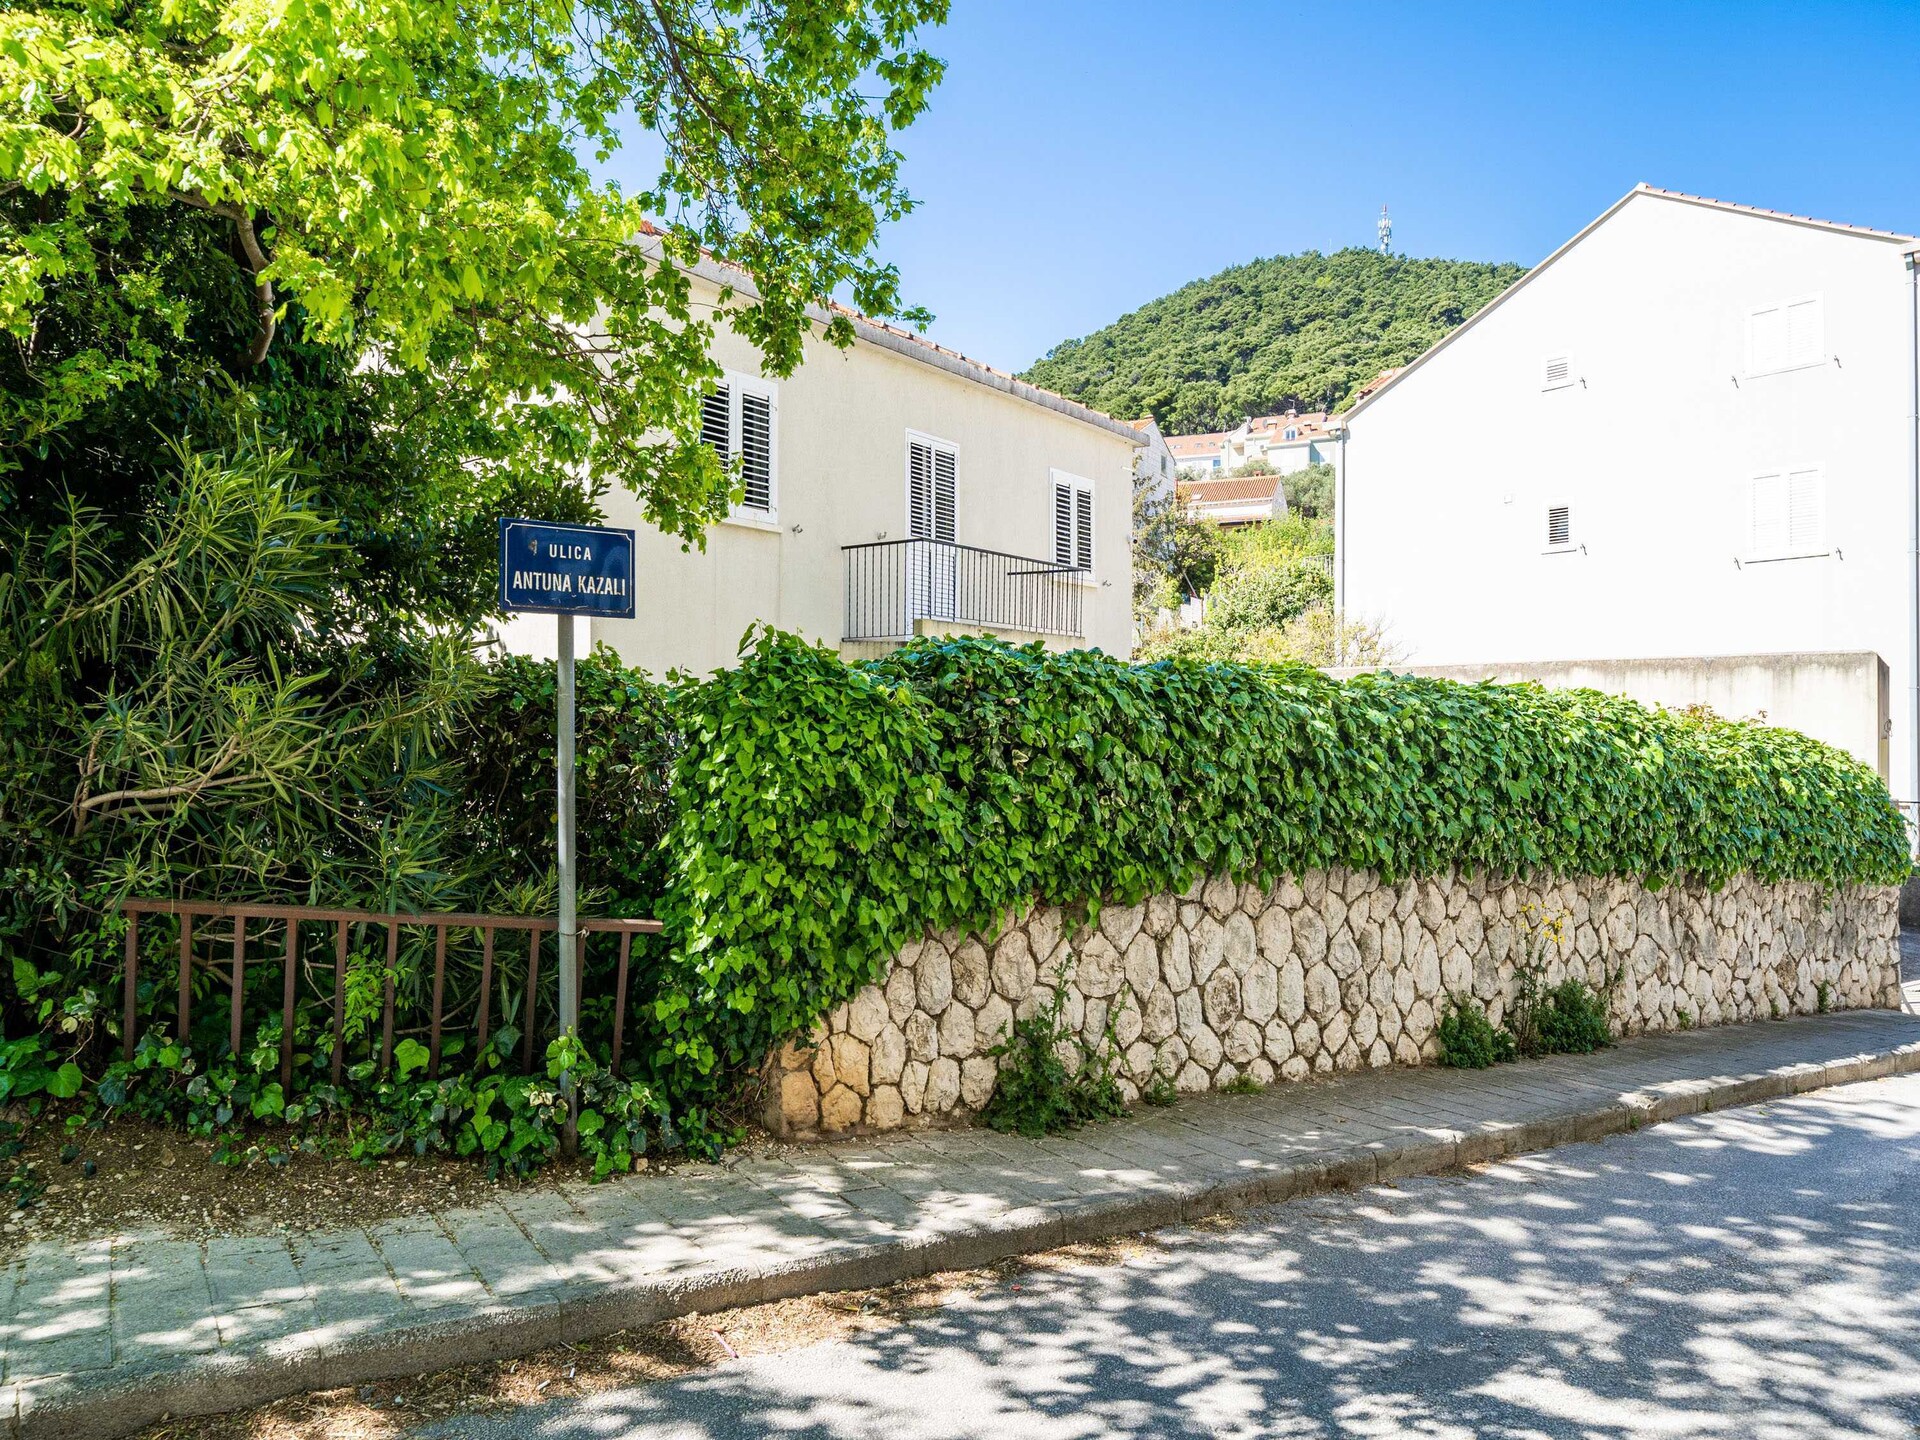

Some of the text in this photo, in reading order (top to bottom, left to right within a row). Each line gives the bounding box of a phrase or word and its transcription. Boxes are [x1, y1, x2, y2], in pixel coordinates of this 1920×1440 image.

[549, 544, 592, 560] ULICA
[512, 570, 626, 596] ANTUNA KAZALI
